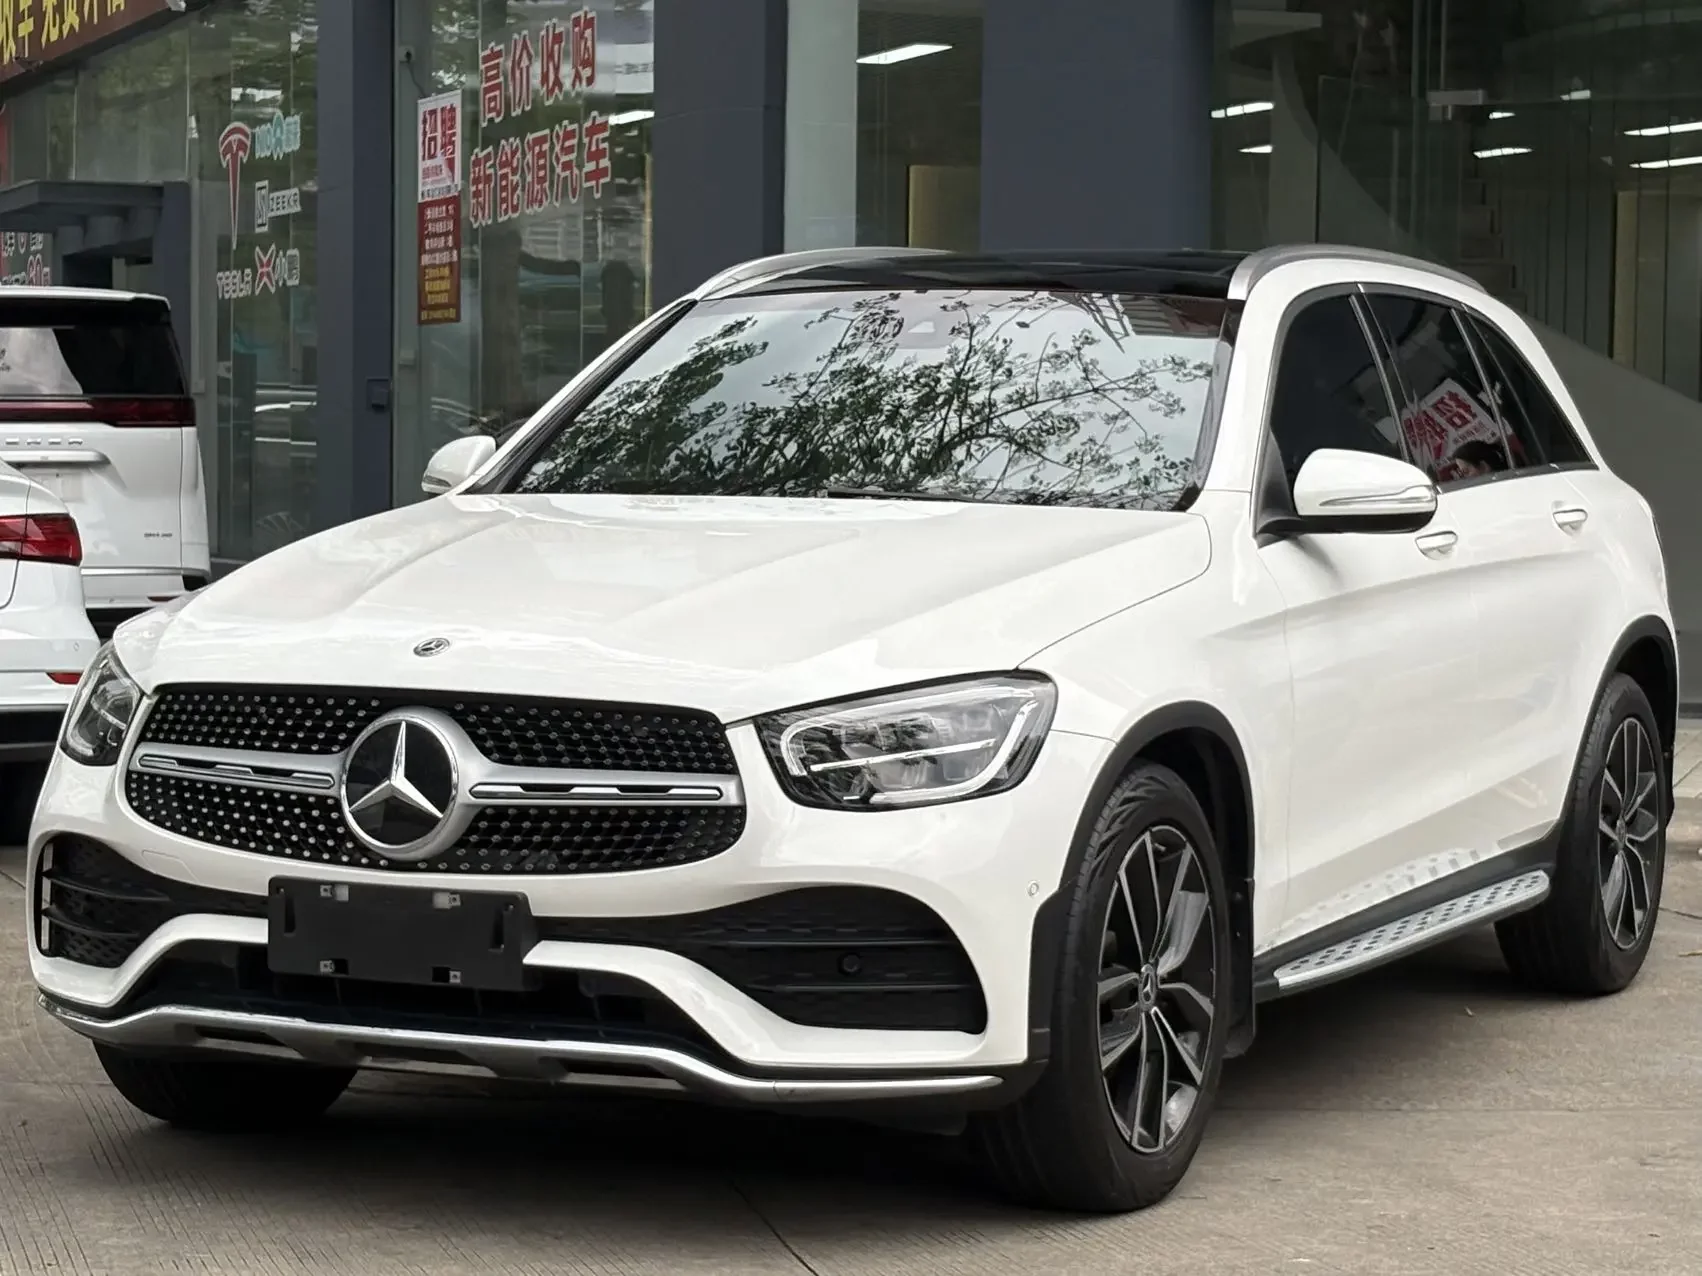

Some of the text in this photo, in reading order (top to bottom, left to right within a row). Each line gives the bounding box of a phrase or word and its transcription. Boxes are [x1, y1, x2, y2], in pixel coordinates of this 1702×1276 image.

[480, 7, 597, 126] 高价收购
[422, 103, 457, 161] 招聘
[469, 110, 611, 228] 新能源汽车
[270, 190, 300, 214] ZEEKR
